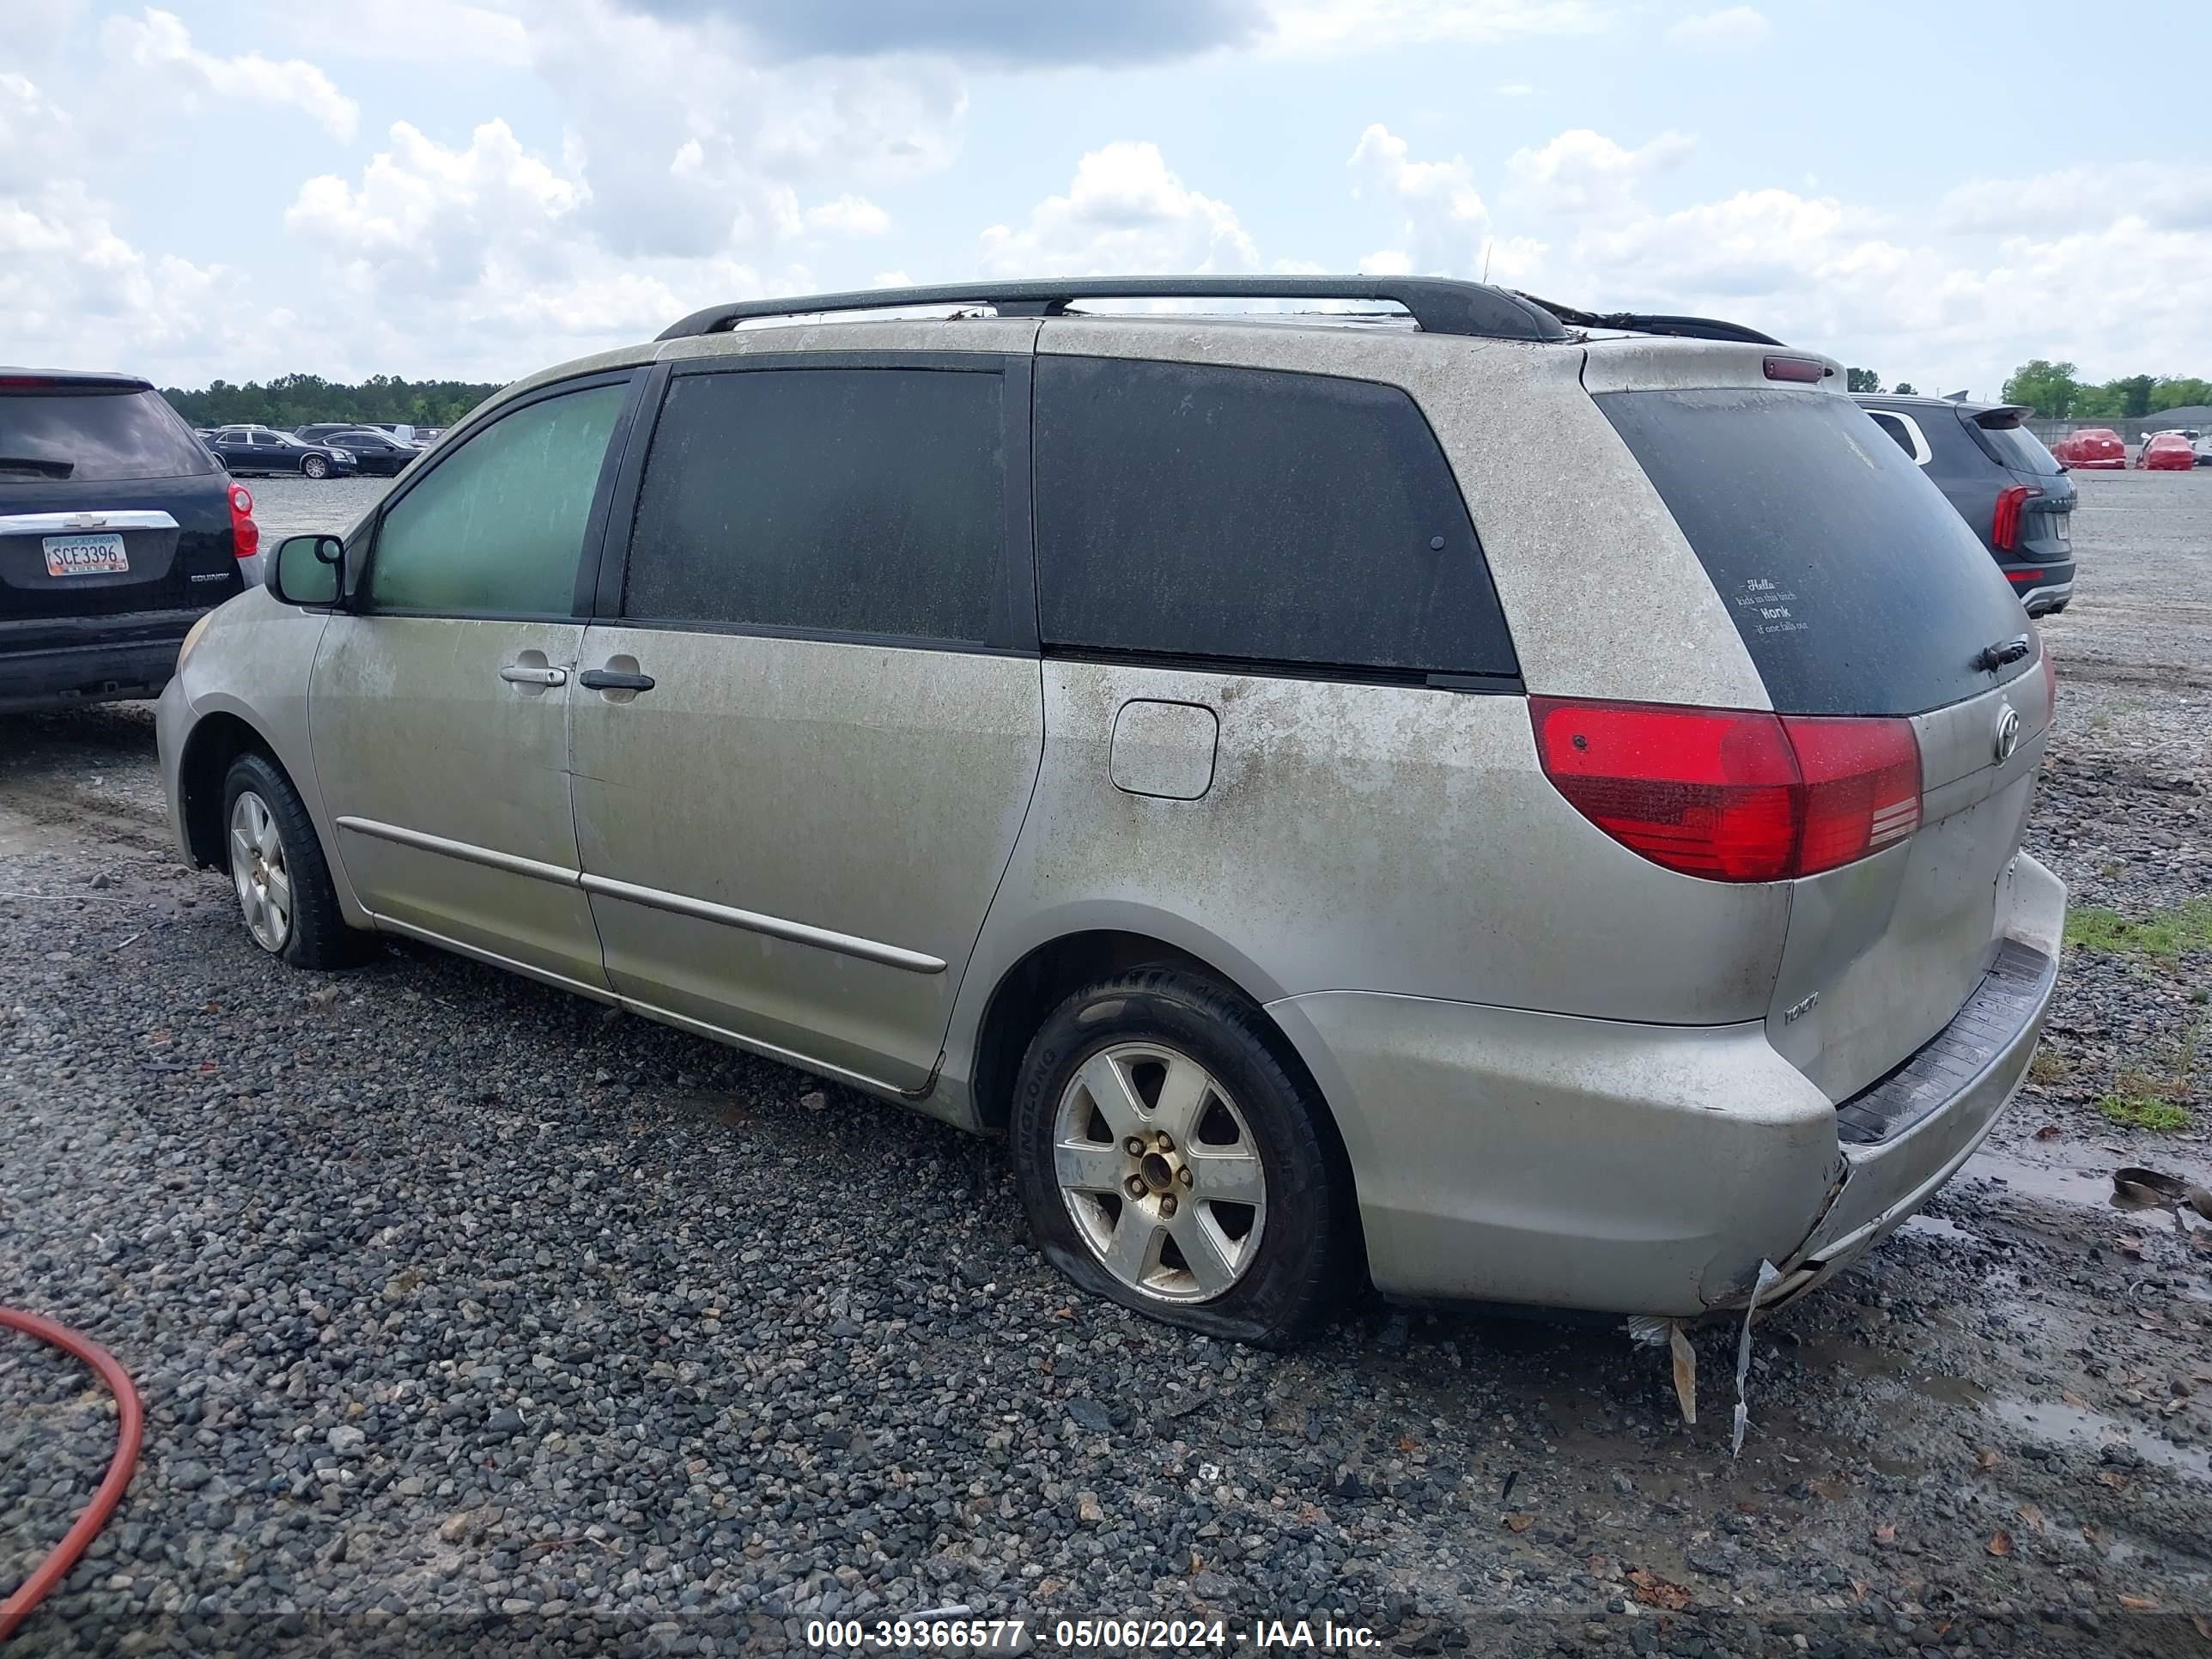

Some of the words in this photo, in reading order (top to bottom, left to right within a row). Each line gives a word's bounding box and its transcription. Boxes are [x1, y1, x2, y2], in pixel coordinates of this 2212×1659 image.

[75, 536, 118, 544] GEORGIA
[53, 545, 117, 565] SCE3396
[191, 573, 229, 582] EQUINOX
[1747, 579, 1776, 591] Hella
[1735, 594, 1755, 605] kids
[1759, 605, 1791, 619] Honk
